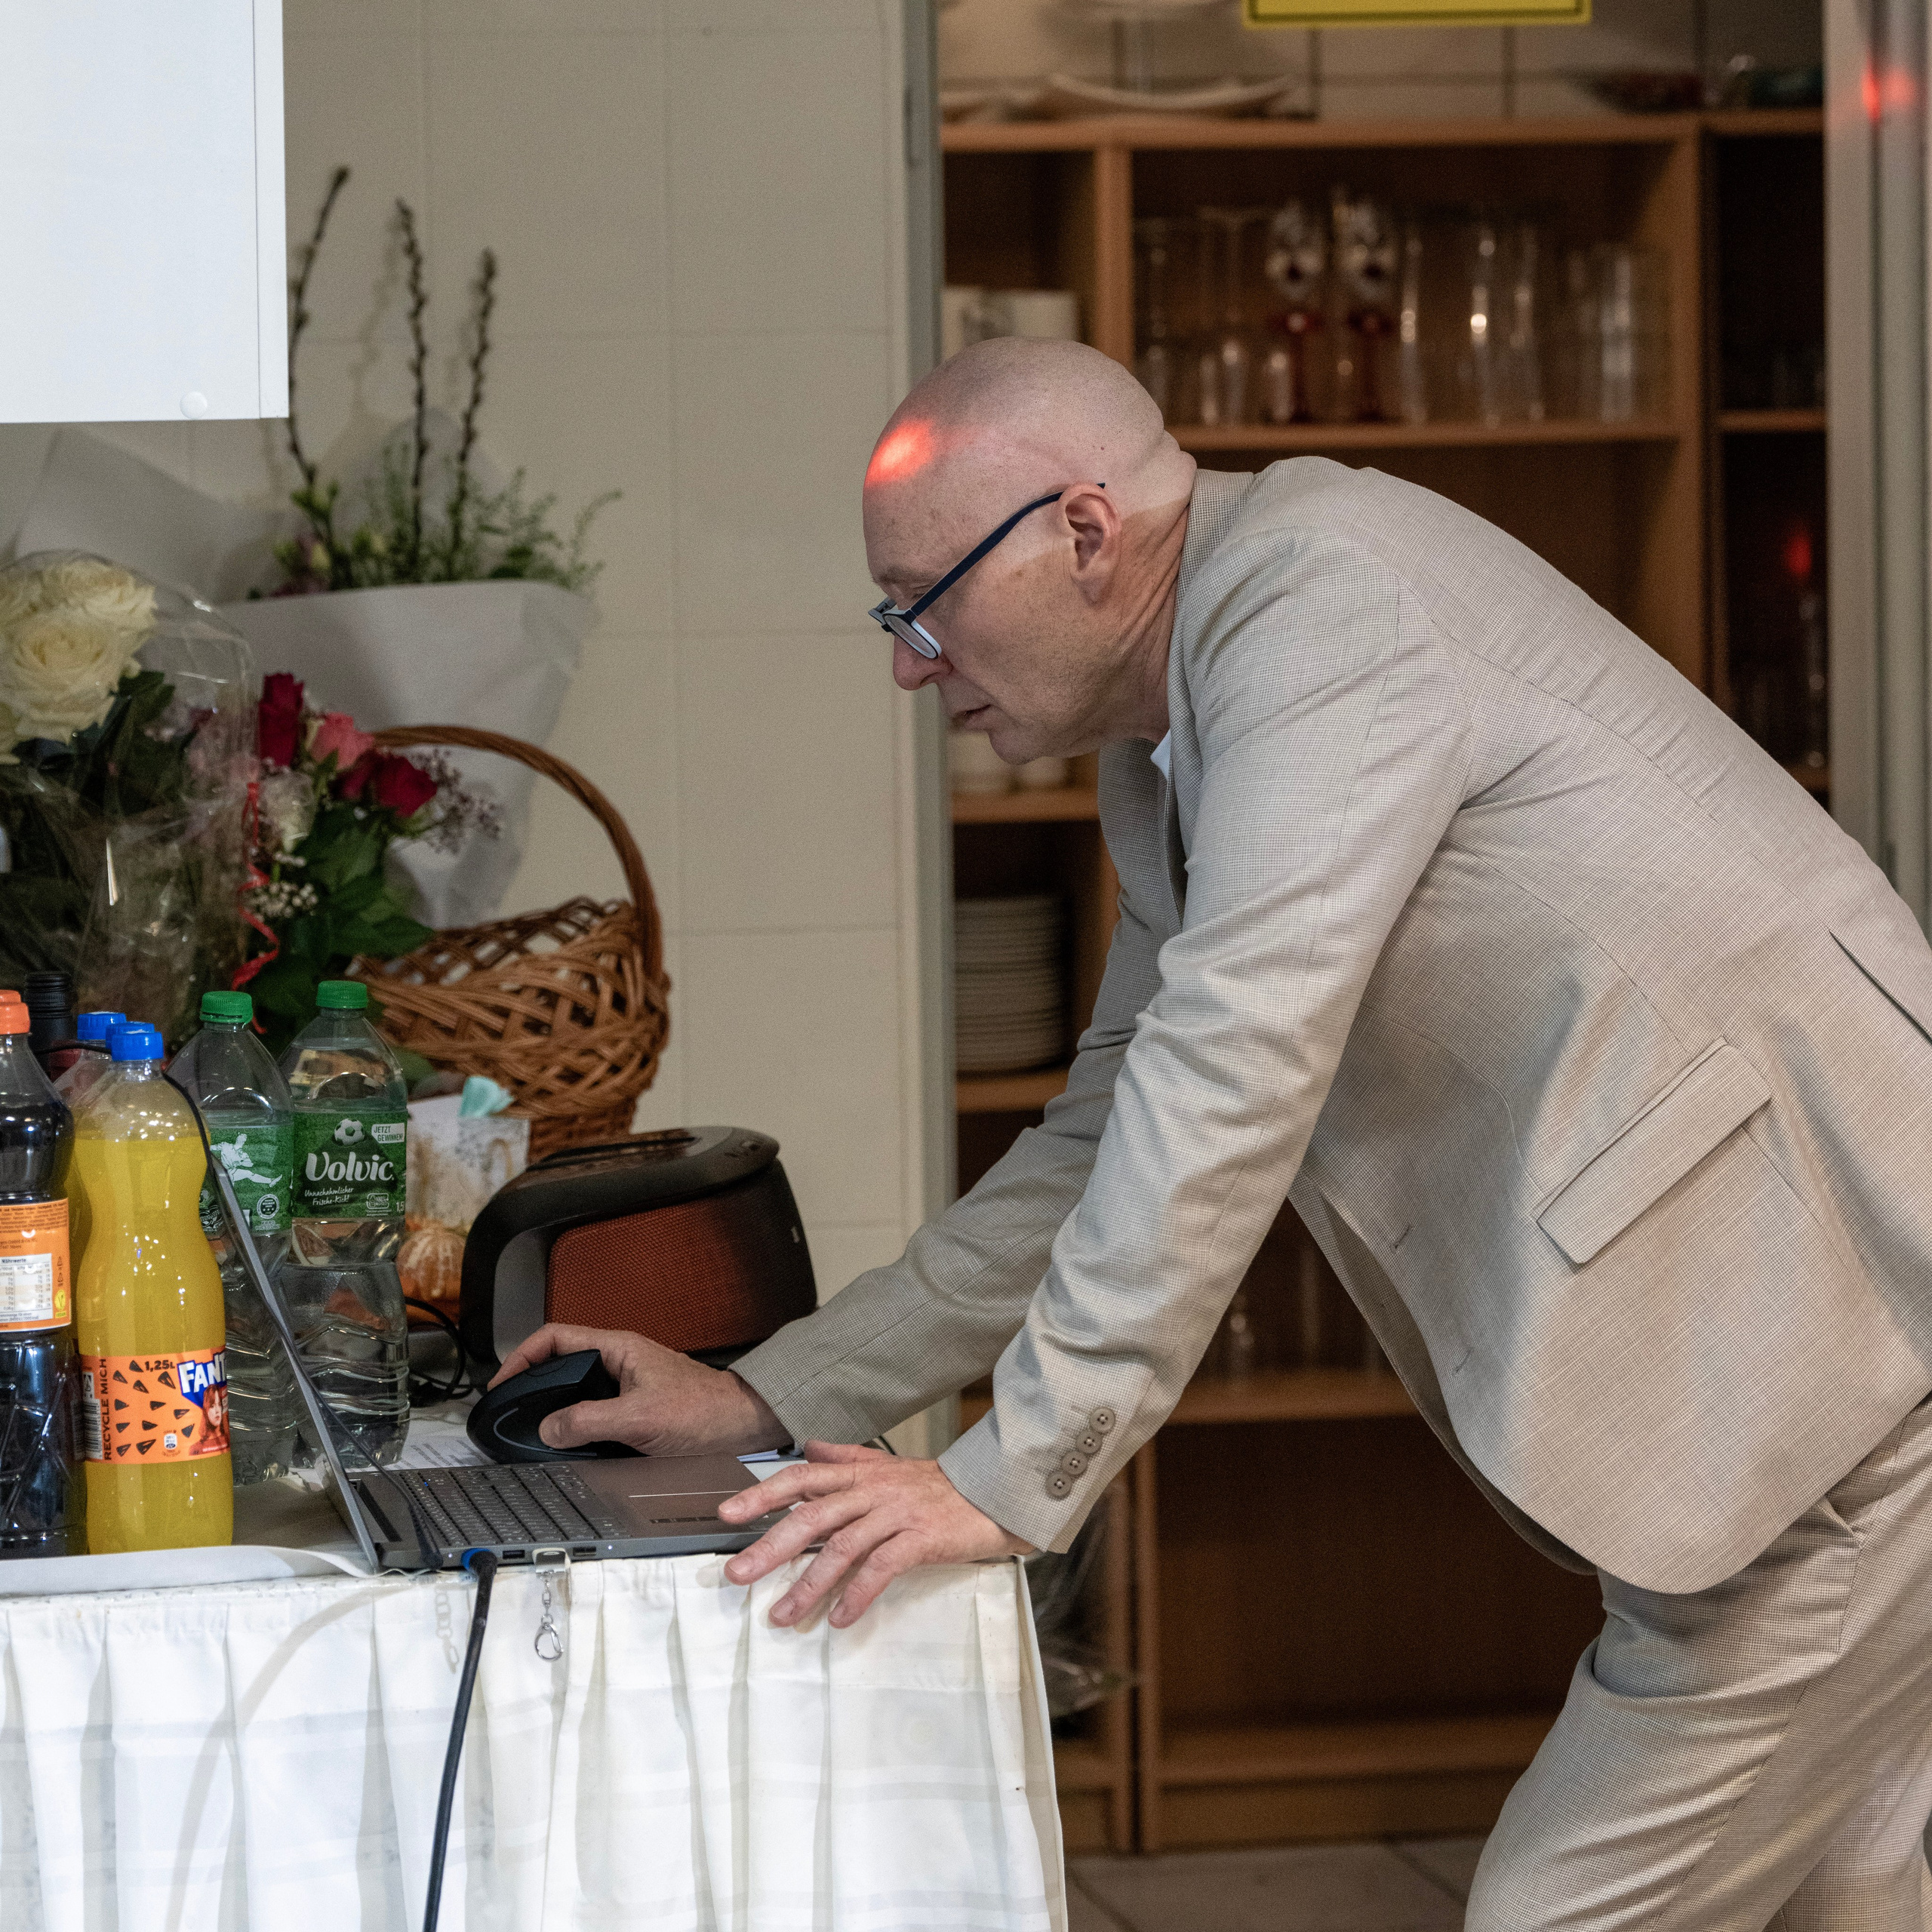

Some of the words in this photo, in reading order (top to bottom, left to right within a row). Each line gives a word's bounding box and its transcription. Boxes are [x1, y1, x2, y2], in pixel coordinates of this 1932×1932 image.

[305, 1151, 393, 1181] Volvic
[304, 1186, 354, 1197] Unnachahmlicher
[312, 1195, 349, 1206] Frische-Kick!
[100, 1358, 108, 1395] MICH
[100, 1398, 112, 1460] RECYCLE
